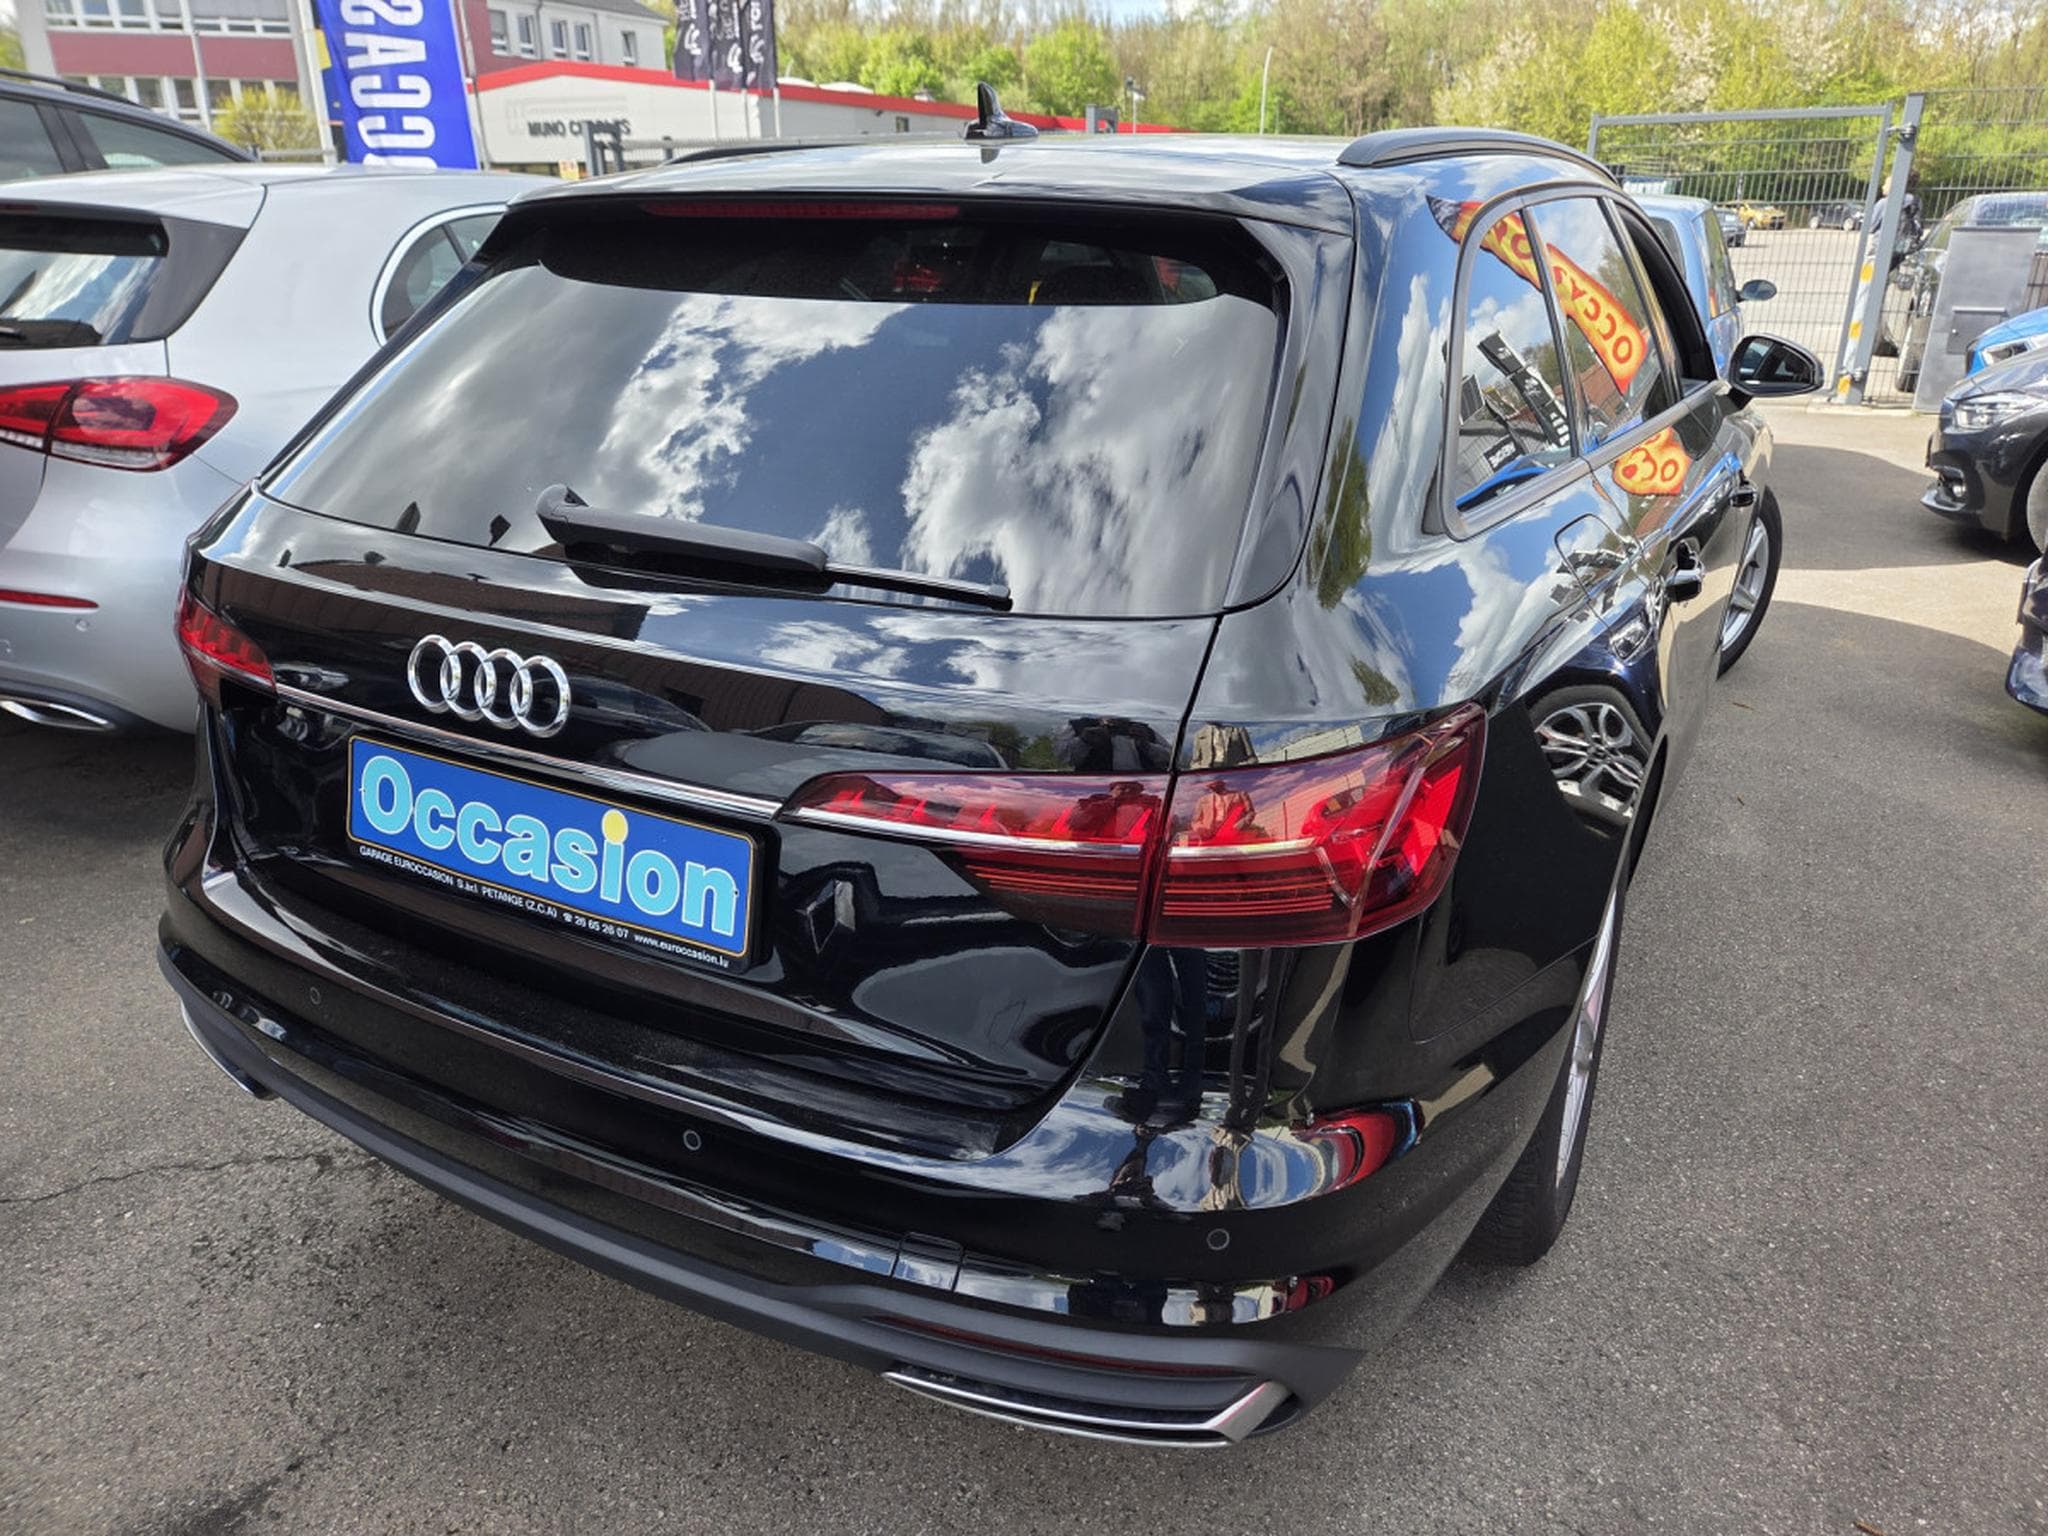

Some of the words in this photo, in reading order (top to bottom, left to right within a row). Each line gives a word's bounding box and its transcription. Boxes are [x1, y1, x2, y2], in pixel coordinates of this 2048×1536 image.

[359, 844, 393, 864] GARAGE
[393, 856, 454, 886] EUROCCASION
[633, 933, 730, 967] www.euroccasion.lu
[361, 754, 738, 936] Occasion
